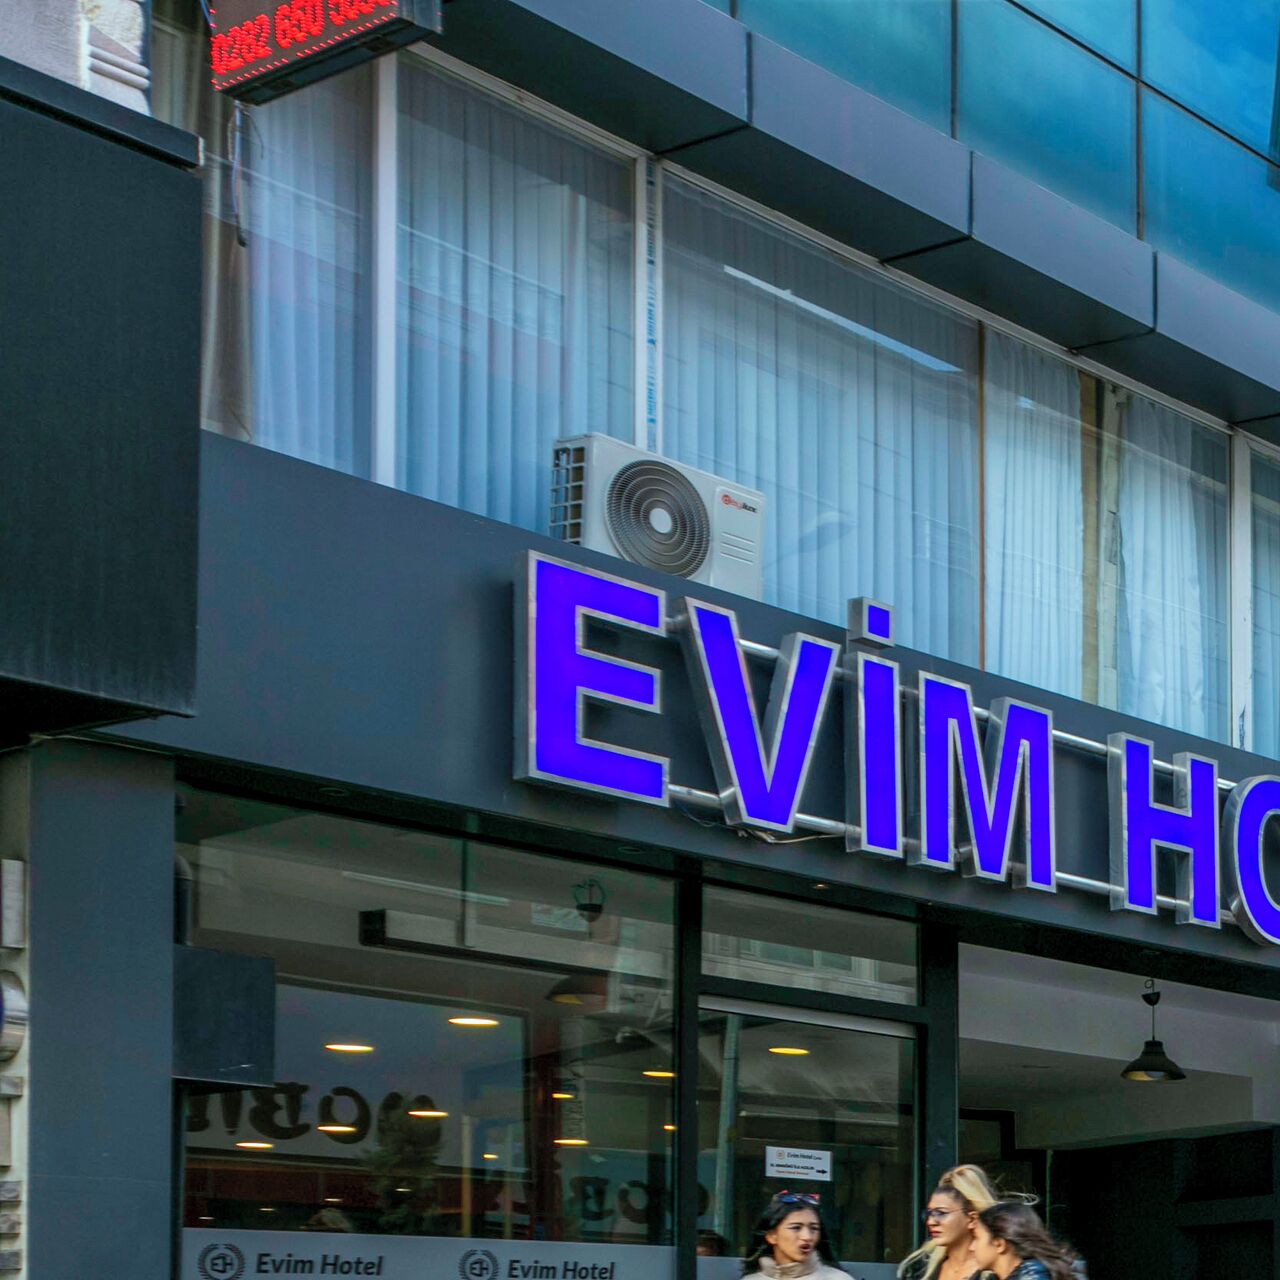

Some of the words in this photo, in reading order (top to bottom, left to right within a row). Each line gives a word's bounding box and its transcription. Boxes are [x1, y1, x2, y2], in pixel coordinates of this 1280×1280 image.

[514, 549, 1057, 893] EVİM
[256, 1252, 314, 1275] Evim
[320, 1254, 384, 1277] Hotel
[507, 1259, 557, 1279] Evim
[562, 1261, 616, 1280] Hotel
